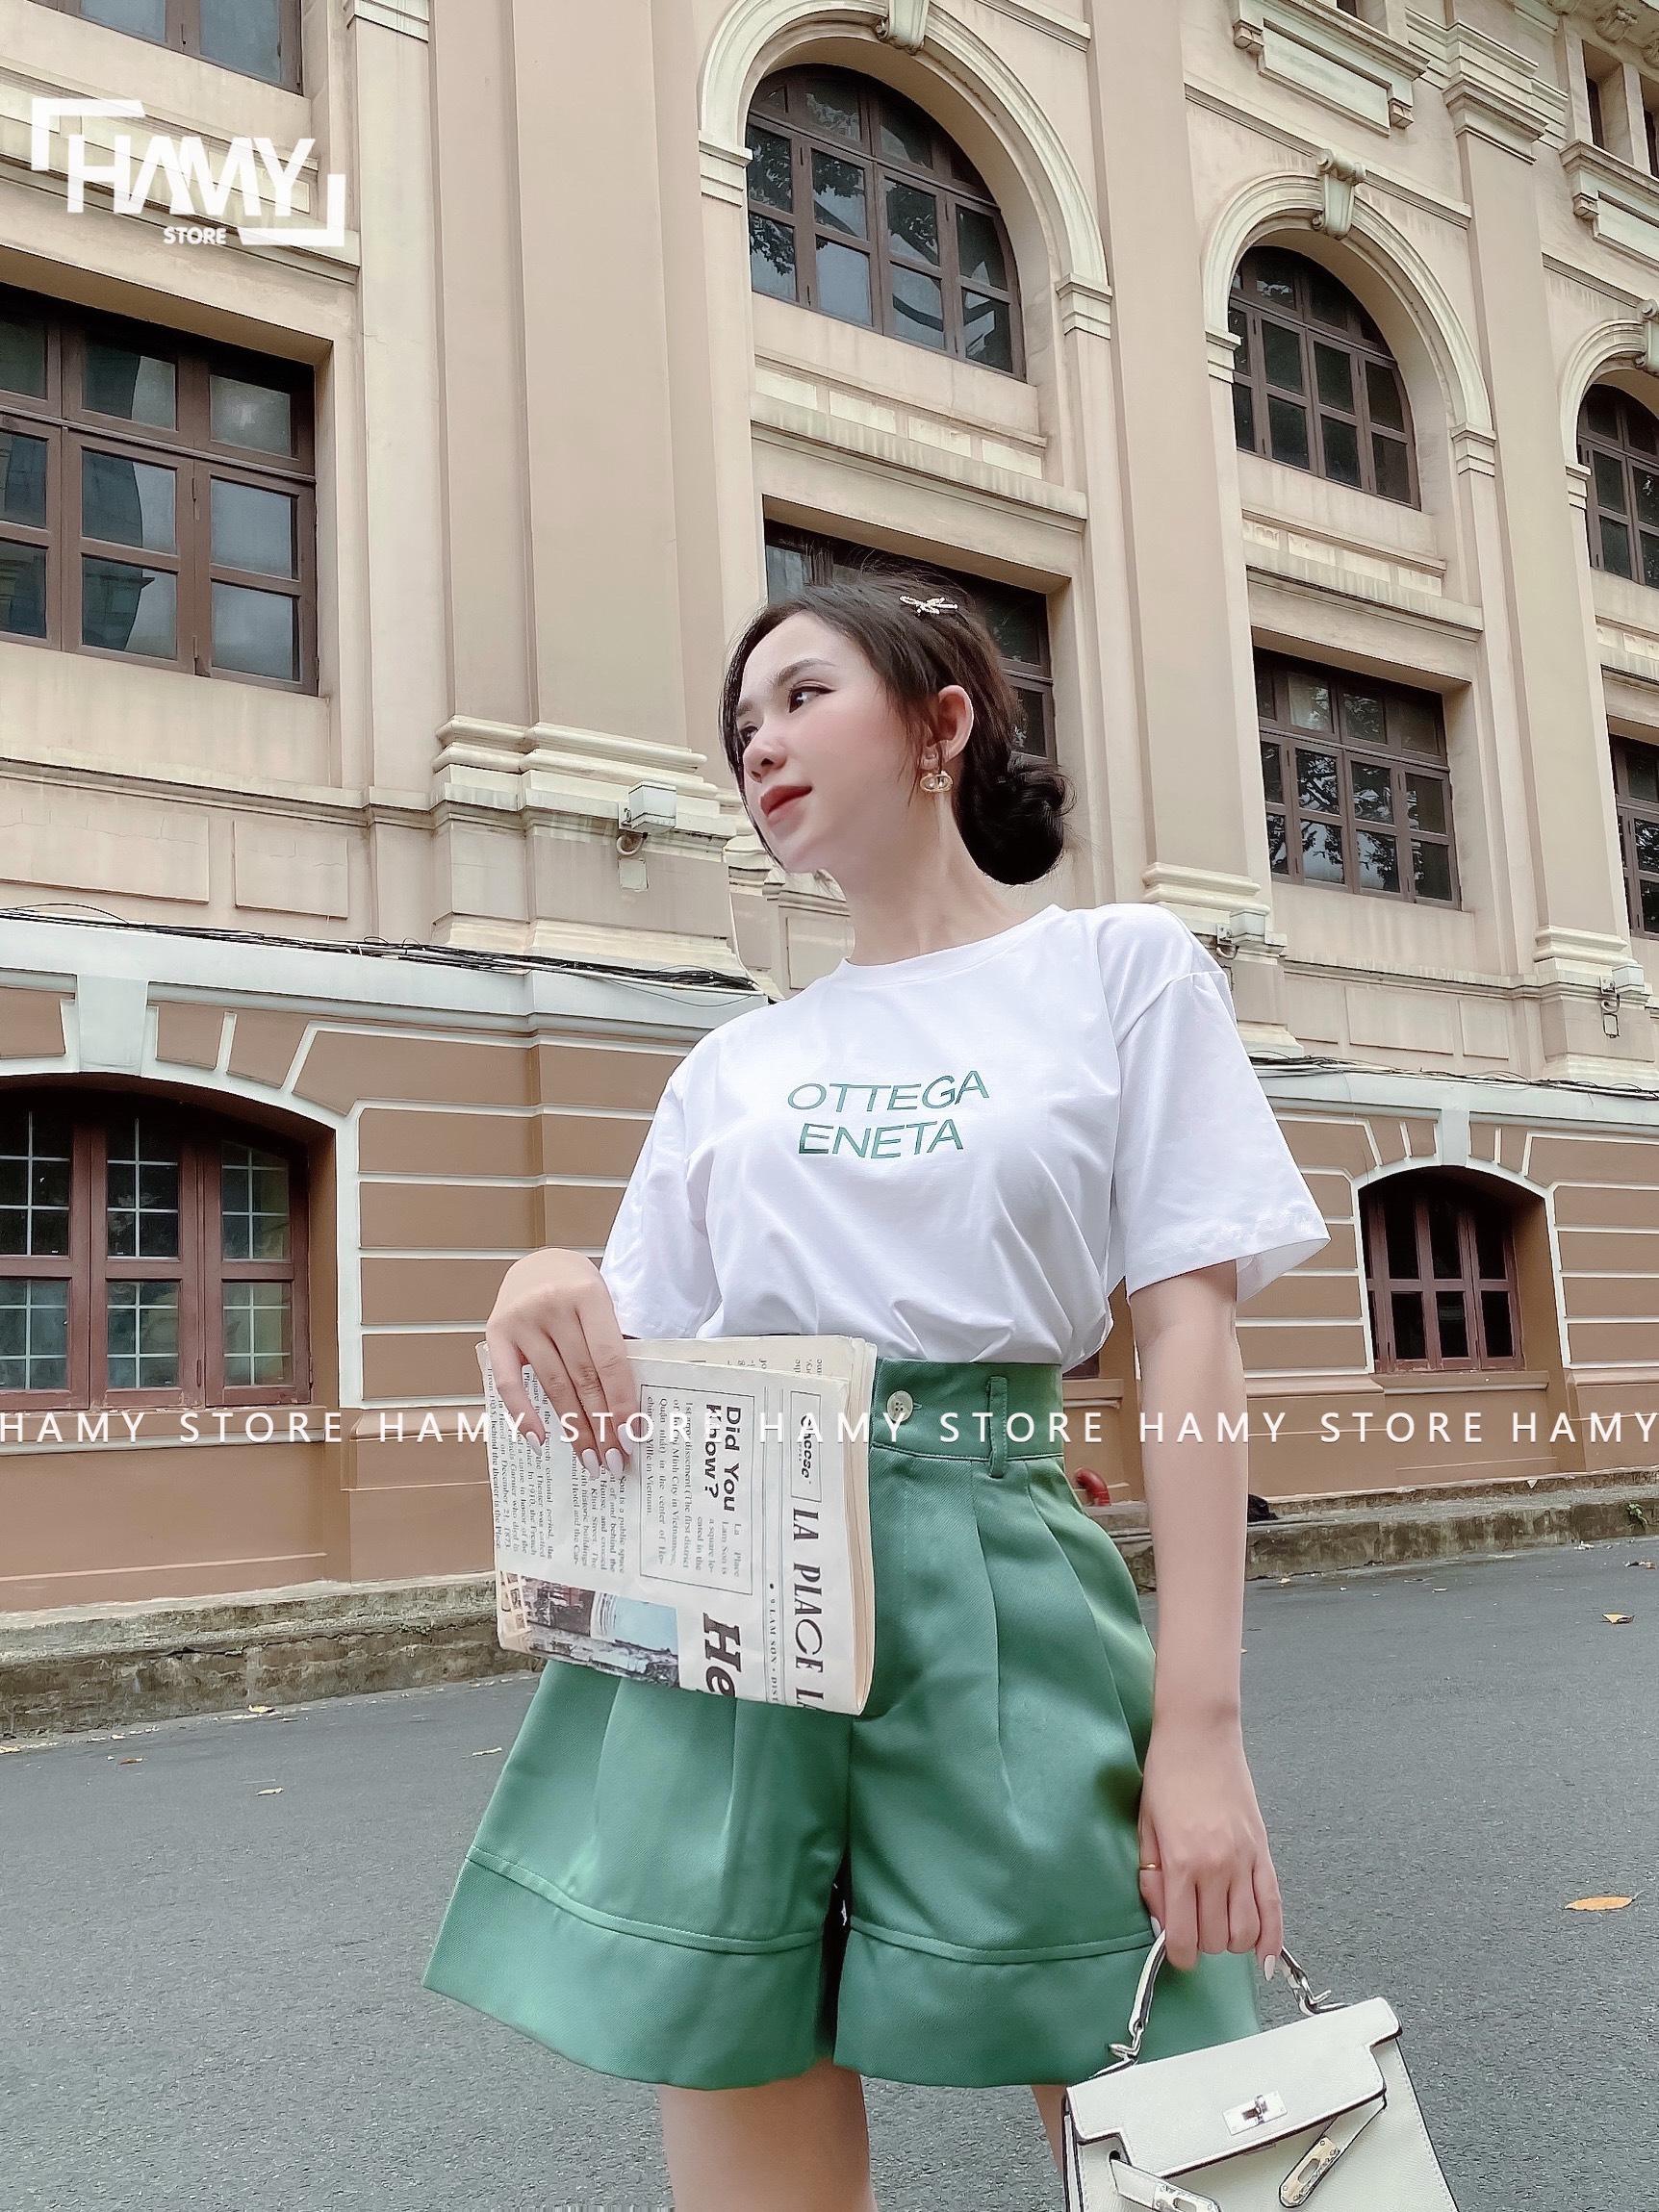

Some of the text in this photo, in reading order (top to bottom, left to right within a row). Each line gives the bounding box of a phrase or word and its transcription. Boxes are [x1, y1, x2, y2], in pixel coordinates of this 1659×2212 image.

[787, 1070, 990, 1112] OTTEGA
[799, 1118, 963, 1158] ENETA
[647, 1462, 654, 1472] in
[724, 1407, 741, 1512] Did You
[500, 1460, 509, 1505] December
[545, 1467, 554, 1503] colonial
[671, 1476, 679, 1495] City
[581, 1489, 590, 1523] historic
[511, 1521, 520, 1541] died
[618, 1516, 627, 1545] public
[658, 1530, 666, 1540] of
[733, 1524, 742, 1536] La
[793, 1508, 819, 1540] LA
[512, 1543, 520, 1552] in
[581, 1525, 591, 1566] buildings
[697, 1544, 703, 1553] in
[721, 1521, 729, 1575] Lam Son is
[695, 1557, 703, 1570] the
[793, 1563, 824, 1673] PLACE
[702, 1613, 741, 1697] He
